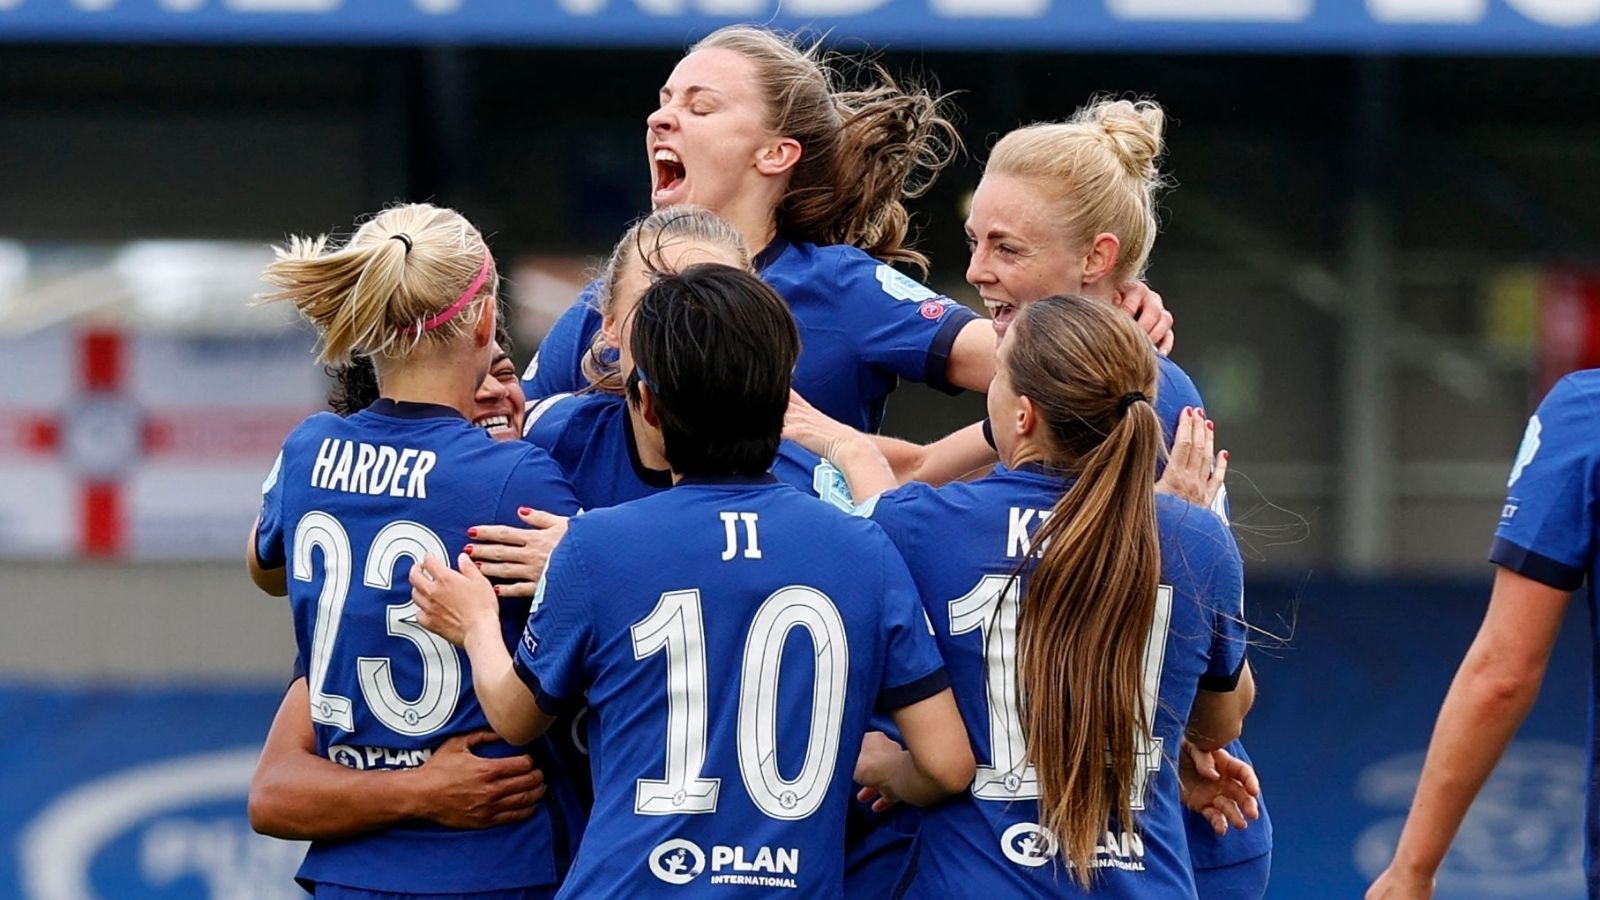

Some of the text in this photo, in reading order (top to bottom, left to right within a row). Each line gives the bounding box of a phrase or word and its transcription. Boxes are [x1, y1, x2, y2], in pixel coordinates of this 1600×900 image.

[311, 438, 437, 499] HARDER
[719, 511, 762, 561] JI
[293, 510, 462, 736] 23
[630, 584, 849, 821] 10
[364, 746, 433, 767] PLAN
[710, 874, 798, 888] INTERNATIONAL
[711, 845, 799, 875] PLAN
